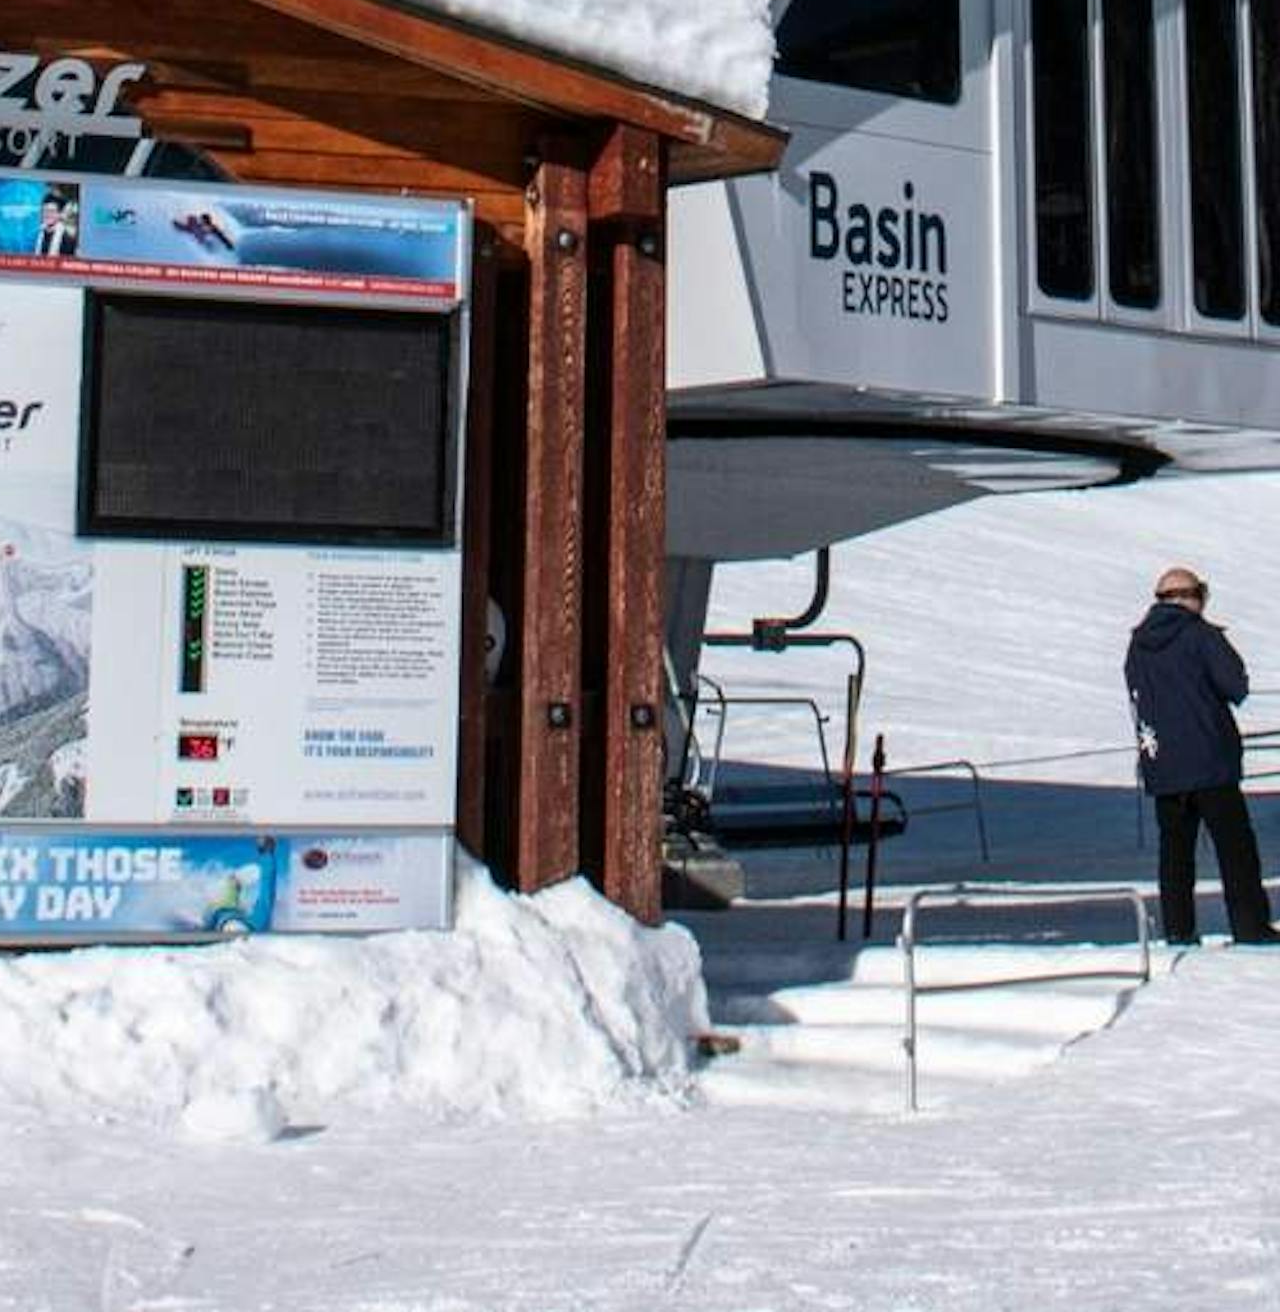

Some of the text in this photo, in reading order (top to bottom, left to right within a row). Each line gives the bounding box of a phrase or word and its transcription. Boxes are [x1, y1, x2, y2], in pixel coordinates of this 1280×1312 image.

[809, 170, 947, 275] Basin
[843, 270, 948, 323] EXPRESS
[48, 847, 183, 882] THOSE
[36, 886, 122, 922] DAY
